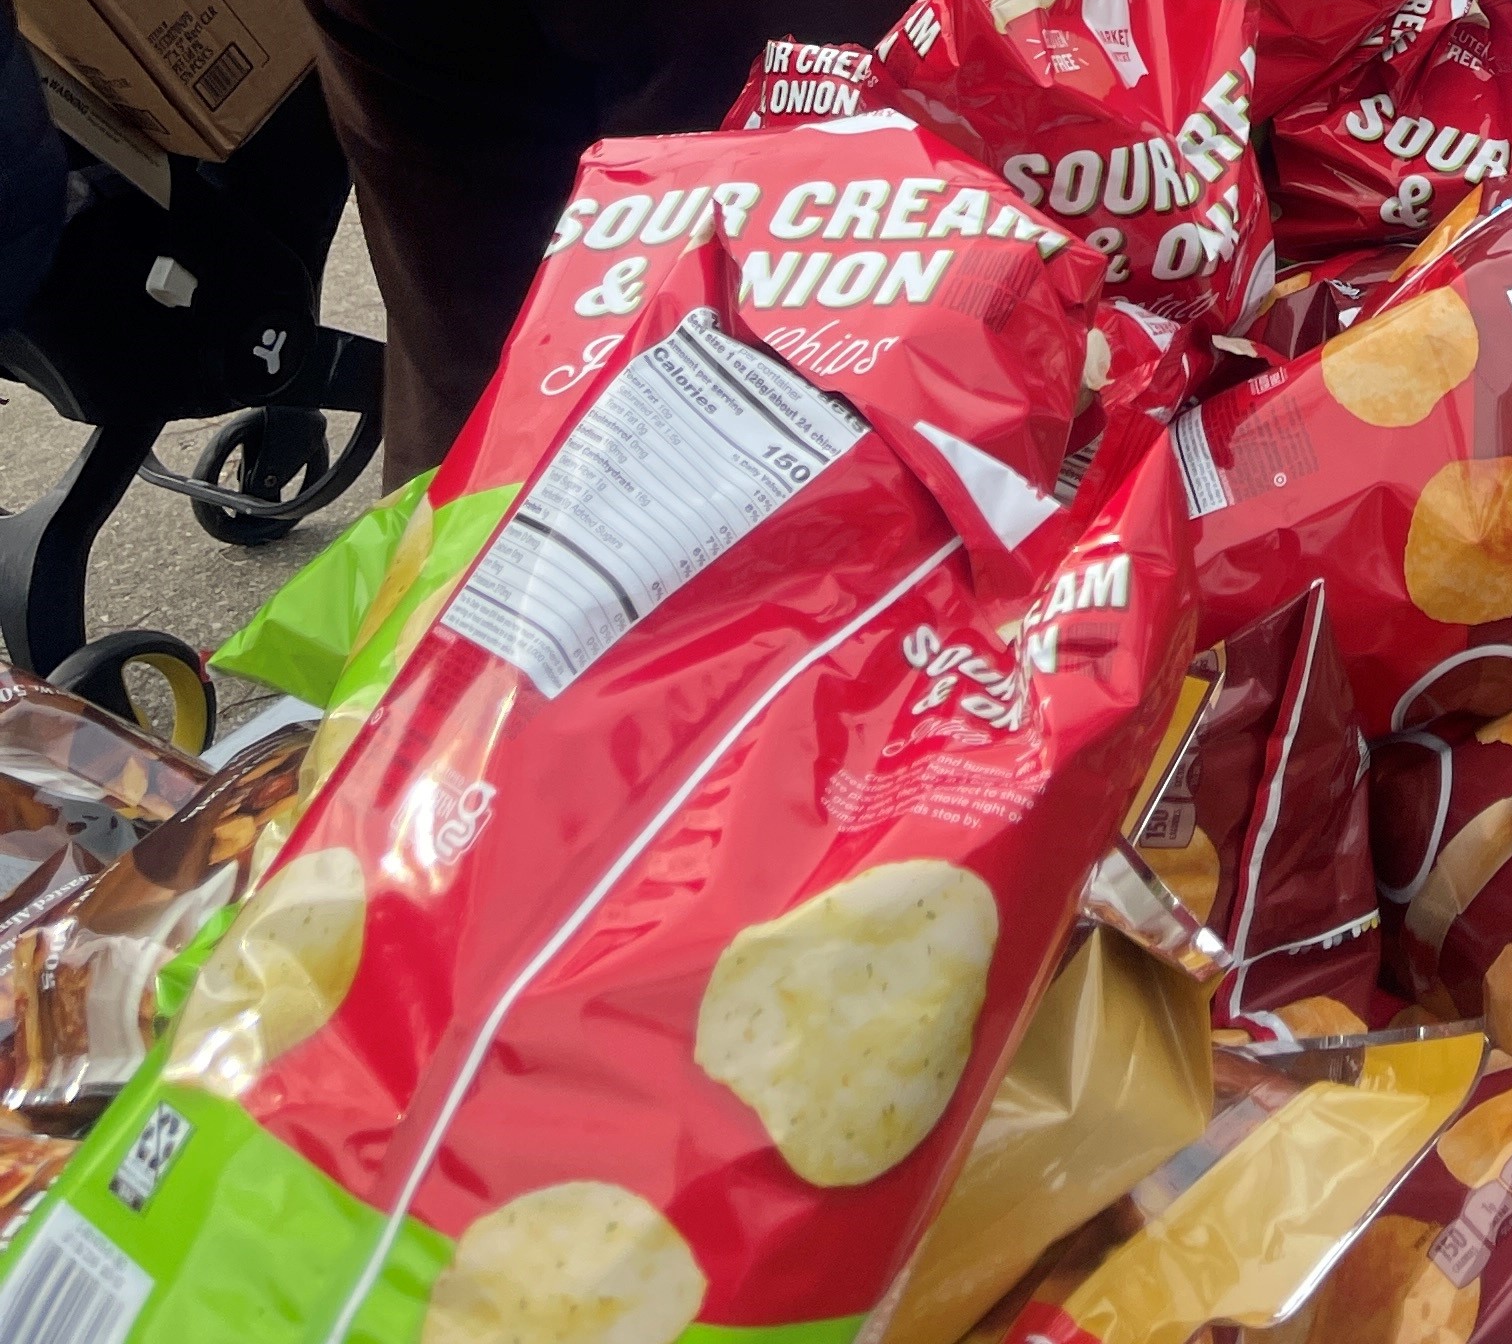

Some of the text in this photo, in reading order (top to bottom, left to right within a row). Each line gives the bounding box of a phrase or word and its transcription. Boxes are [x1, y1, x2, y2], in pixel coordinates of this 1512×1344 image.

[769, 79, 861, 116] ONION
[1346, 94, 1512, 184] SOUR
[1003, 141, 1188, 216] SOUR
[1380, 178, 1434, 229] &
[543, 180, 761, 259] SOUR
[769, 177, 1071, 258] CREAM
[1094, 227, 1131, 283] &
[573, 249, 955, 318] & NION
[666, 337, 744, 416] Amount per serving
[704, 332, 842, 457] size 1 oz (28g/about 24 chips)
[737, 347, 803, 402] per container
[622, 409, 639, 426] Fat
[652, 345, 718, 416] Calories
[761, 443, 812, 485] 150
[581, 445, 636, 494] Carbohydrate
[588, 408, 634, 443] Cholesterol
[718, 524, 735, 546] 0%
[642, 387, 659, 405] Fat
[752, 488, 774, 513] 13%
[570, 502, 600, 534] Added
[594, 524, 625, 551] Sugars
[930, 790, 971, 810] movie
[971, 796, 1006, 818] night
[931, 805, 962, 825] stop
[1434, 1226, 1469, 1263] 150
